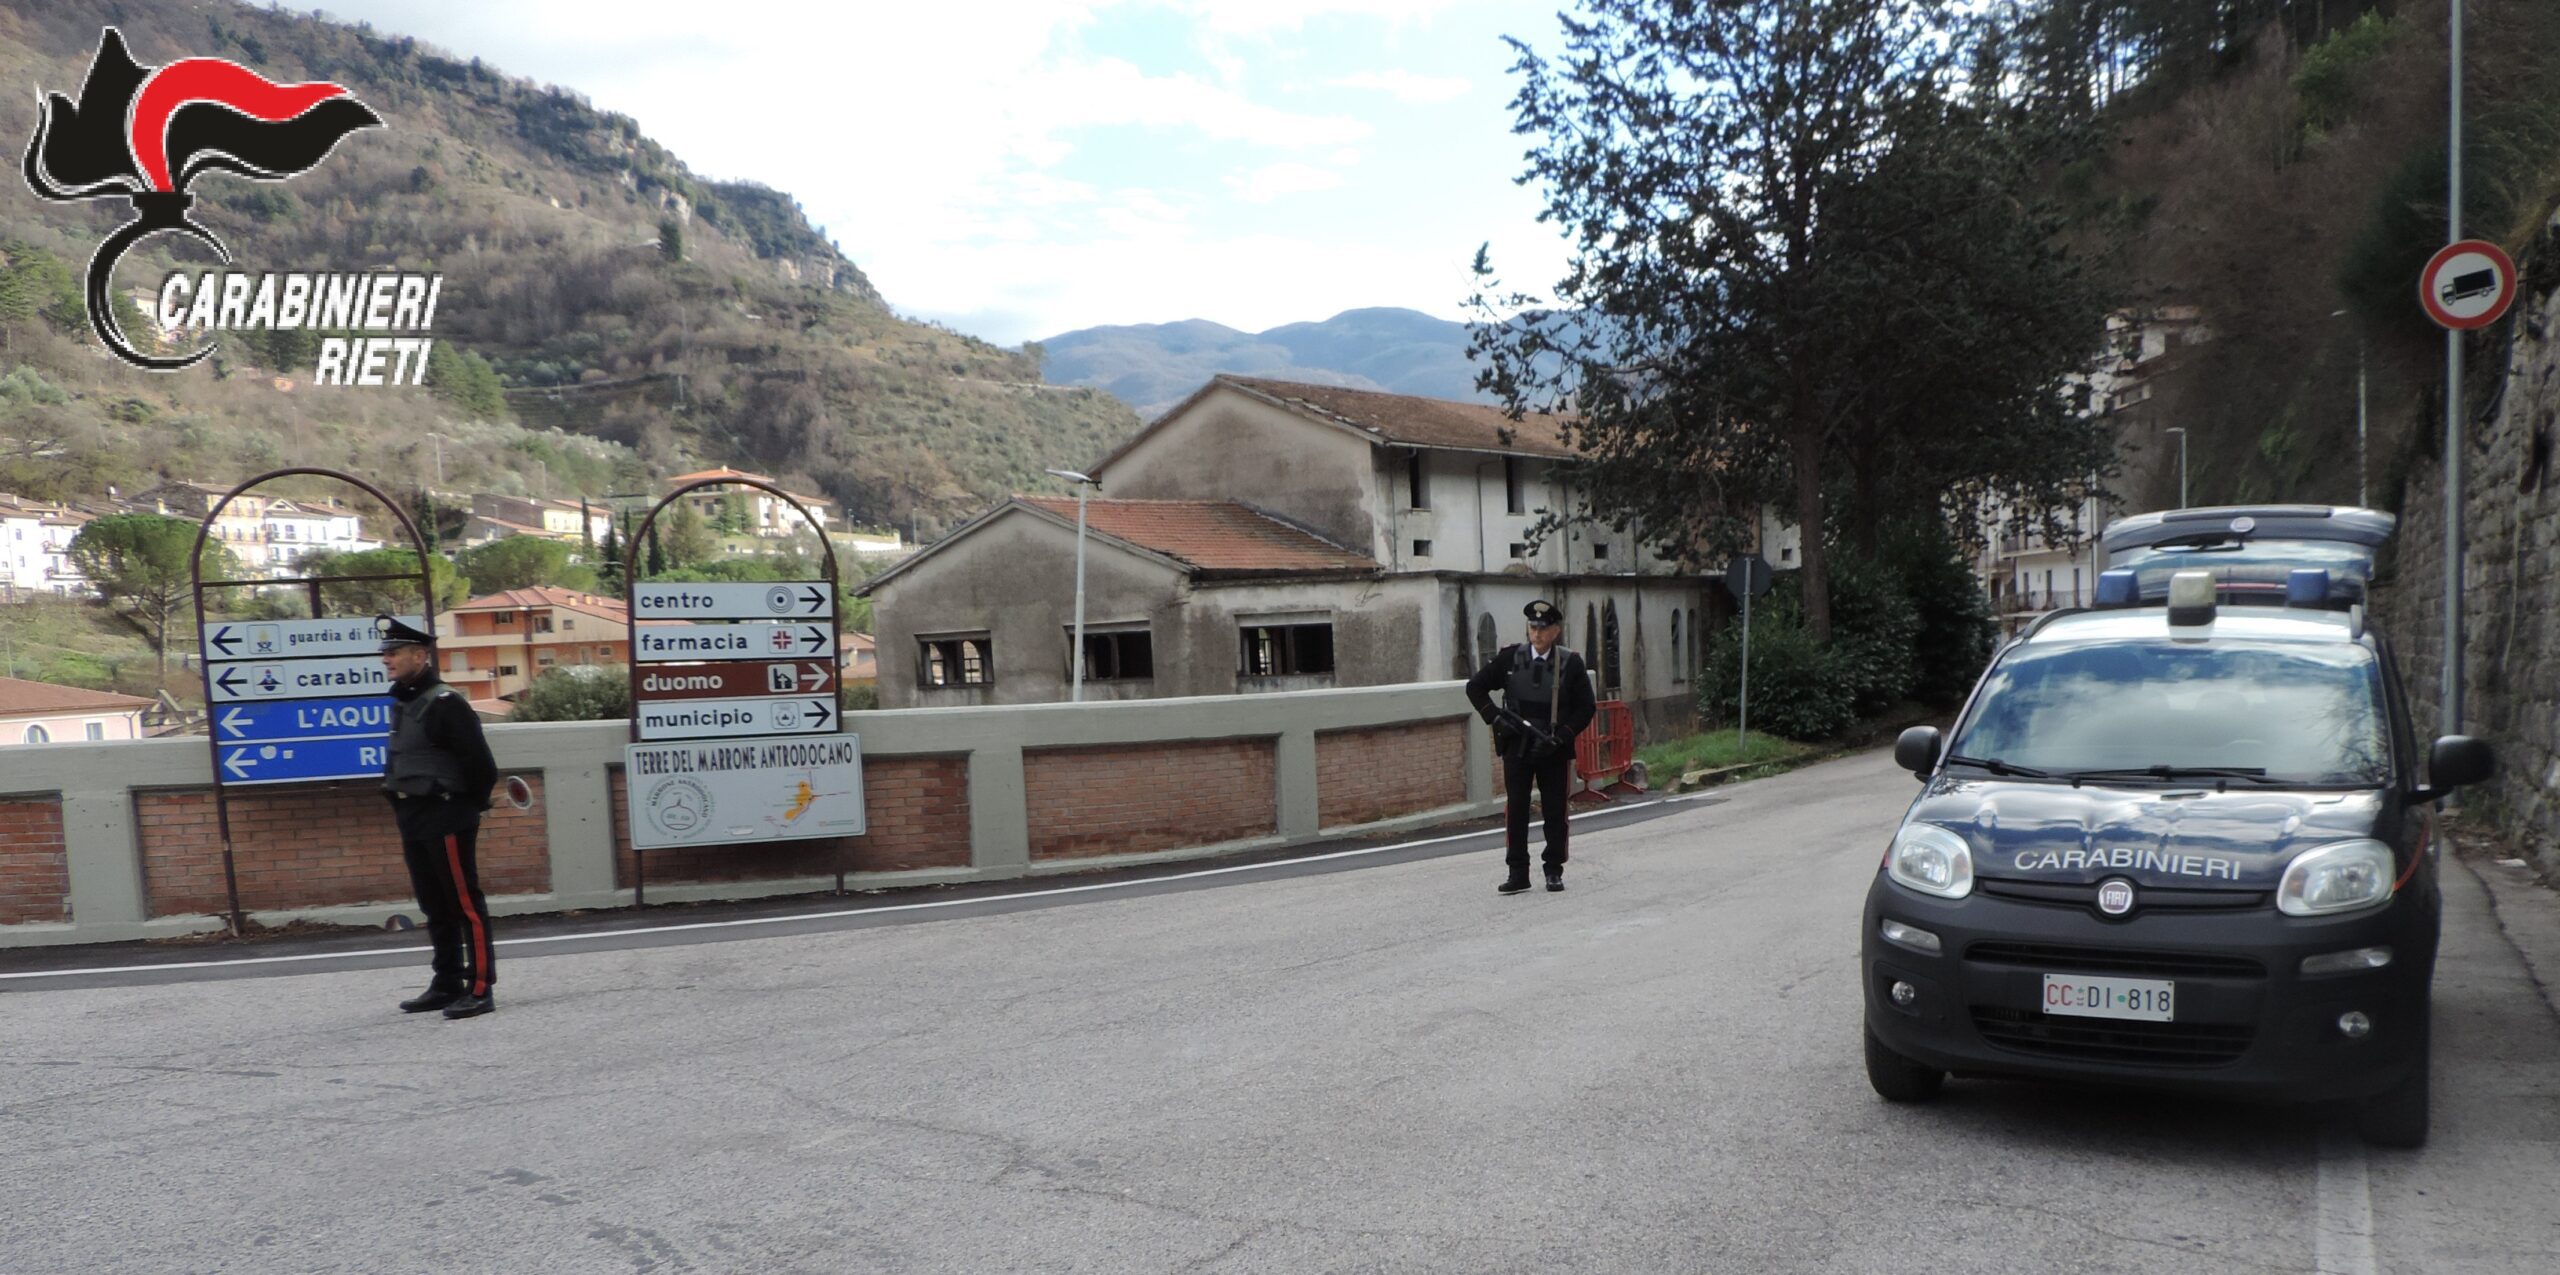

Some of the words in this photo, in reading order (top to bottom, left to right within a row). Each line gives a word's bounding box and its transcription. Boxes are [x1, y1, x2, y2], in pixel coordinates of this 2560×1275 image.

[641, 593, 713, 609] centro
[289, 628, 342, 646] guardia
[349, 628, 361, 640] di
[641, 633, 748, 651] farmacia
[296, 667, 388, 687] carabin
[642, 673, 723, 692] duomo
[297, 705, 391, 728] L'AQUI
[645, 709, 753, 728] municipio
[359, 746, 387, 766] RI
[635, 751, 669, 774] TERRE
[672, 749, 694, 772] DEL
[698, 746, 757, 772] MARRONE
[760, 742, 852, 768] ANTRODOCANO
[2014, 848, 2241, 880] CARABINIERI
[2106, 890, 2128, 906] FIAT
[2046, 984, 2073, 1006] CC
[2087, 986, 2111, 1008] DI
[2128, 989, 2170, 1012] 818
